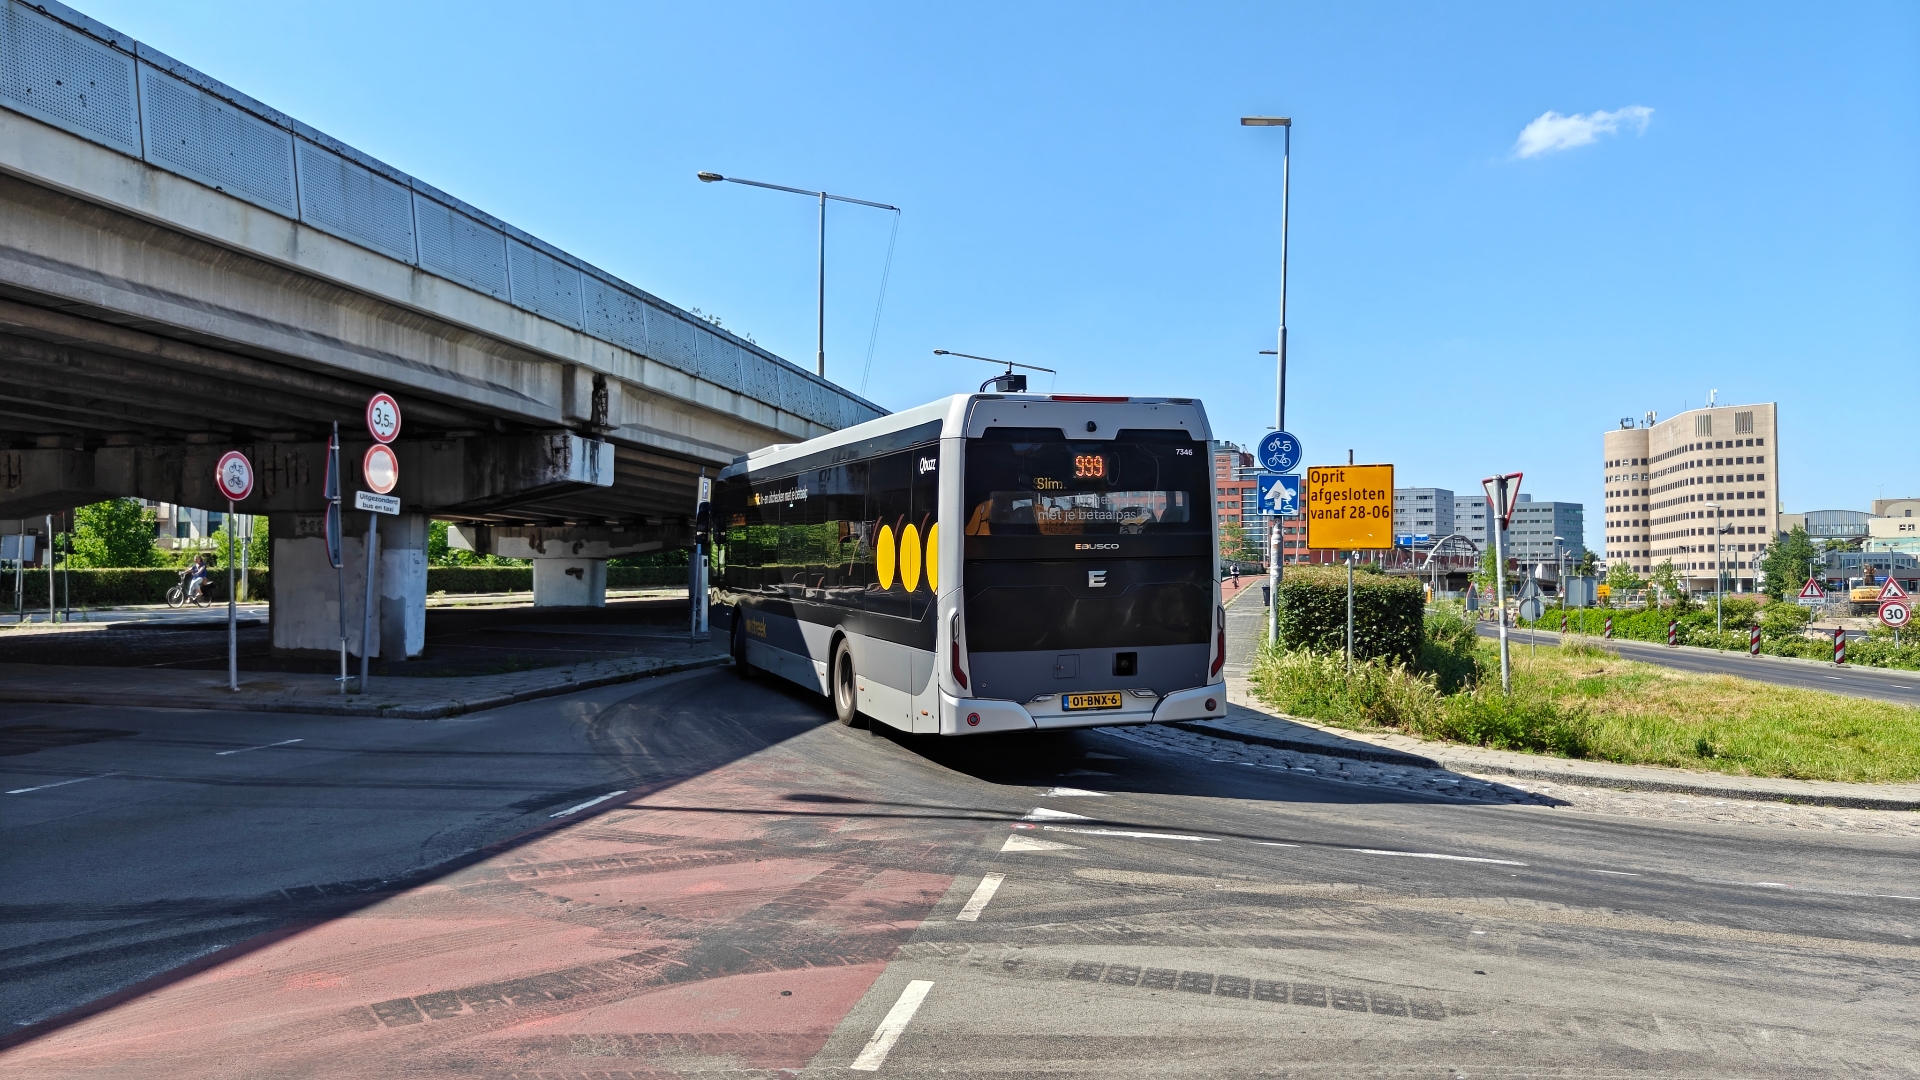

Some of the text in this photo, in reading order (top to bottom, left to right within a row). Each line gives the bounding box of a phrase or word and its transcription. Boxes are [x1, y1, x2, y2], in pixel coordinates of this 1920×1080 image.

[1175, 448, 1193, 456] 7346
[919, 456, 937, 475] Qbuzz
[1075, 455, 1103, 477] 999
[1311, 470, 1346, 487] Oprit
[359, 493, 399, 506] Uitgezonderd
[1310, 488, 1386, 505] afgesloten
[362, 502, 374, 510] bus
[383, 505, 395, 513] taxi
[1310, 506, 1390, 520] vanaf 28-06
[1037, 509, 1062, 520] met
[1064, 508, 1076, 523] je
[1078, 507, 1137, 523] betaalpas
[1885, 608, 1904, 620] 30
[1072, 695, 1118, 707] 01-BNX-6
